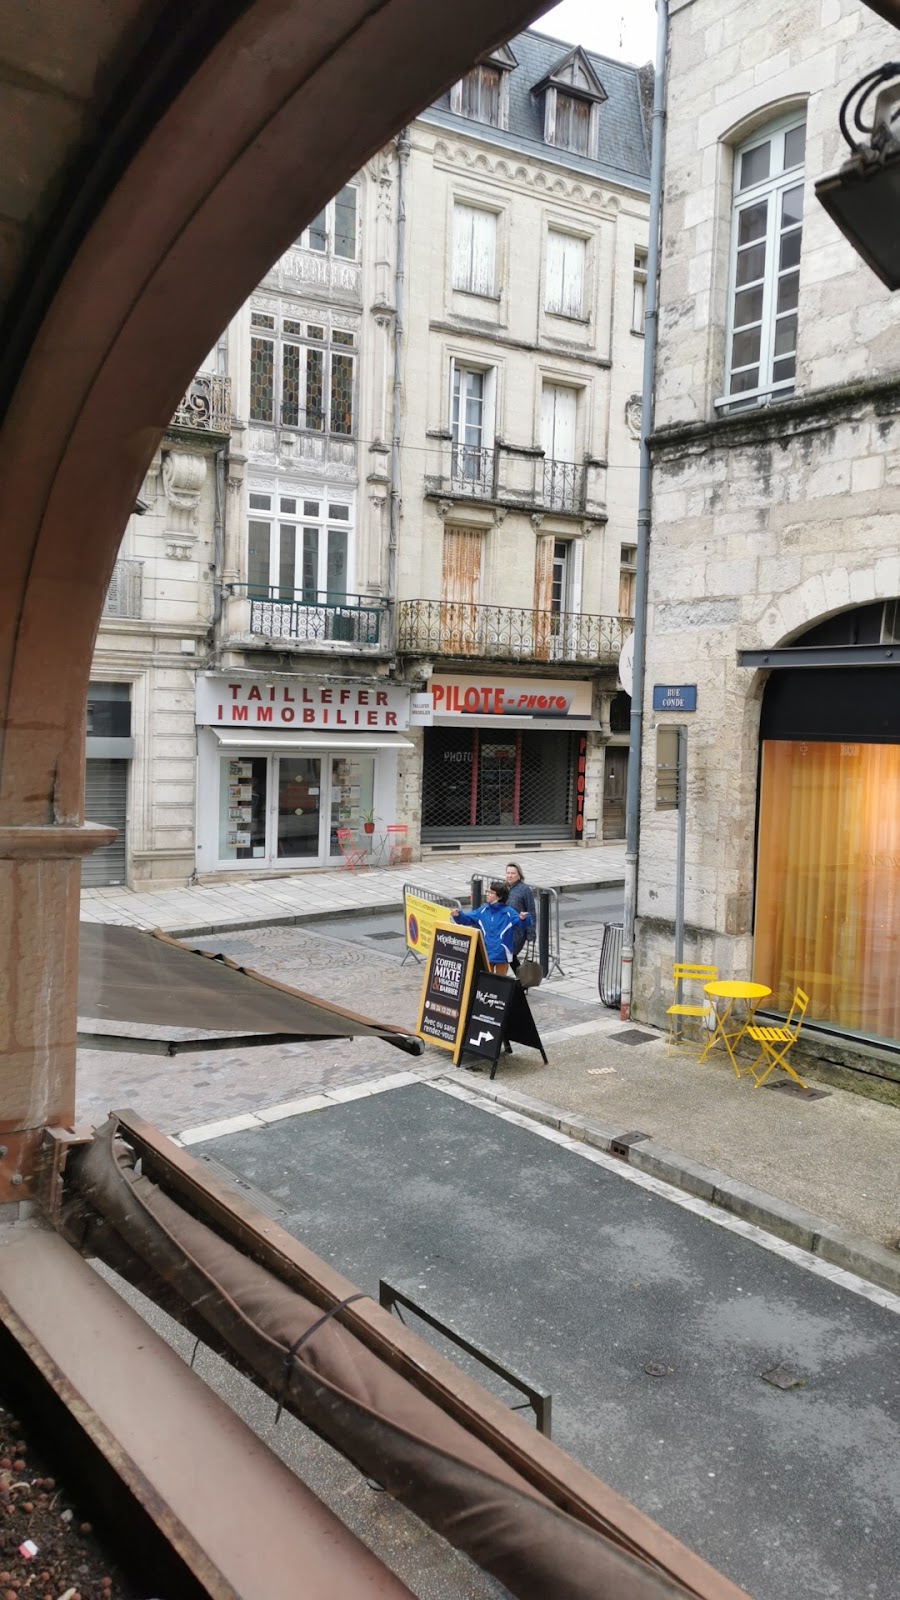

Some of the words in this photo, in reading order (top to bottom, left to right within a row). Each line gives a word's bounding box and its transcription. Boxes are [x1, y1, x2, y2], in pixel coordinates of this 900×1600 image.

[228, 684, 389, 706] TAILLEFER
[431, 684, 505, 714] PILOTE
[517, 694, 567, 710] PHOTO
[667, 688, 681, 697] RUE
[217, 704, 398, 726] IMMOBILIER
[443, 751, 473, 763] PHOTO
[576, 737, 586, 831] PHOTO
[435, 957, 462, 971] COIFFEUR
[434, 965, 462, 983] MIXTE
[423, 1025, 455, 1041] rendez-vous
[424, 1015, 437, 1027] Avec
[443, 1023, 456, 1034] sans
